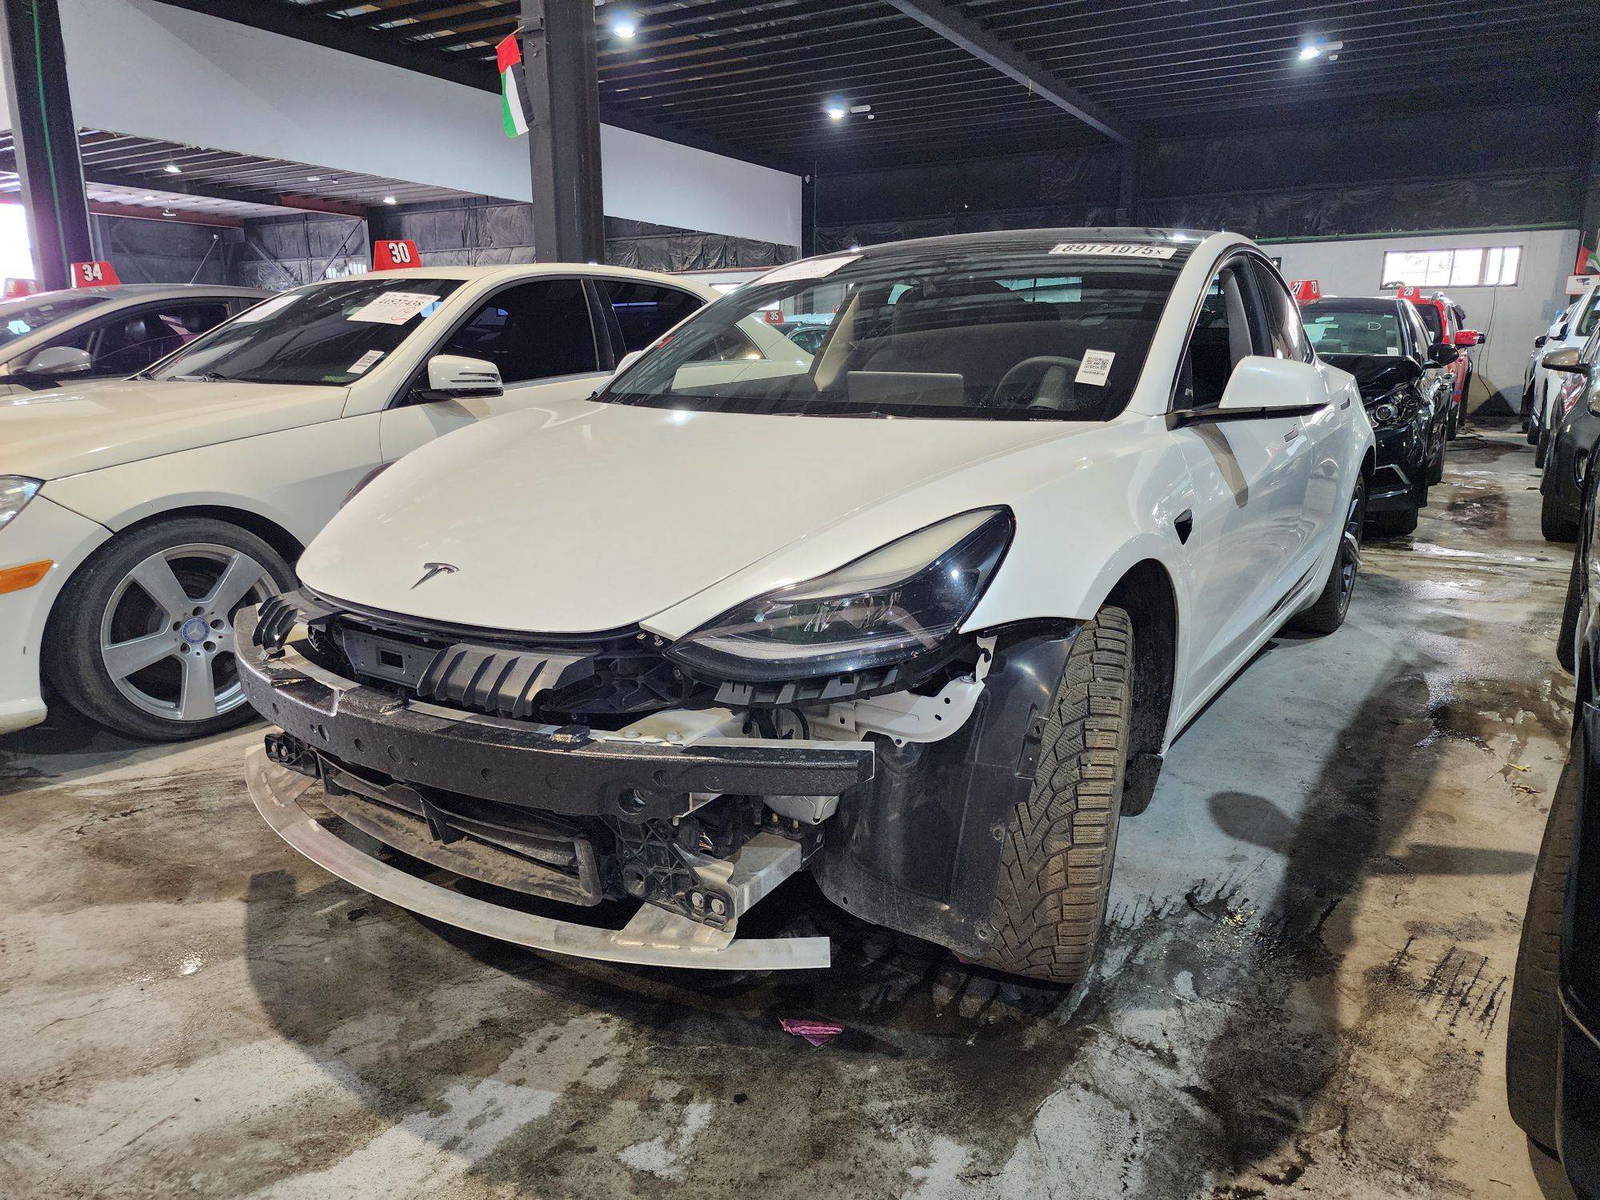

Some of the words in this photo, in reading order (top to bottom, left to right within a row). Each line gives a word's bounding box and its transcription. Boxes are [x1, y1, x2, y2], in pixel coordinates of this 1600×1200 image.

[388, 242, 411, 264] 30
[82, 263, 103, 282] 34
[1403, 286, 1414, 296] 28
[769, 311, 780, 321] 35
